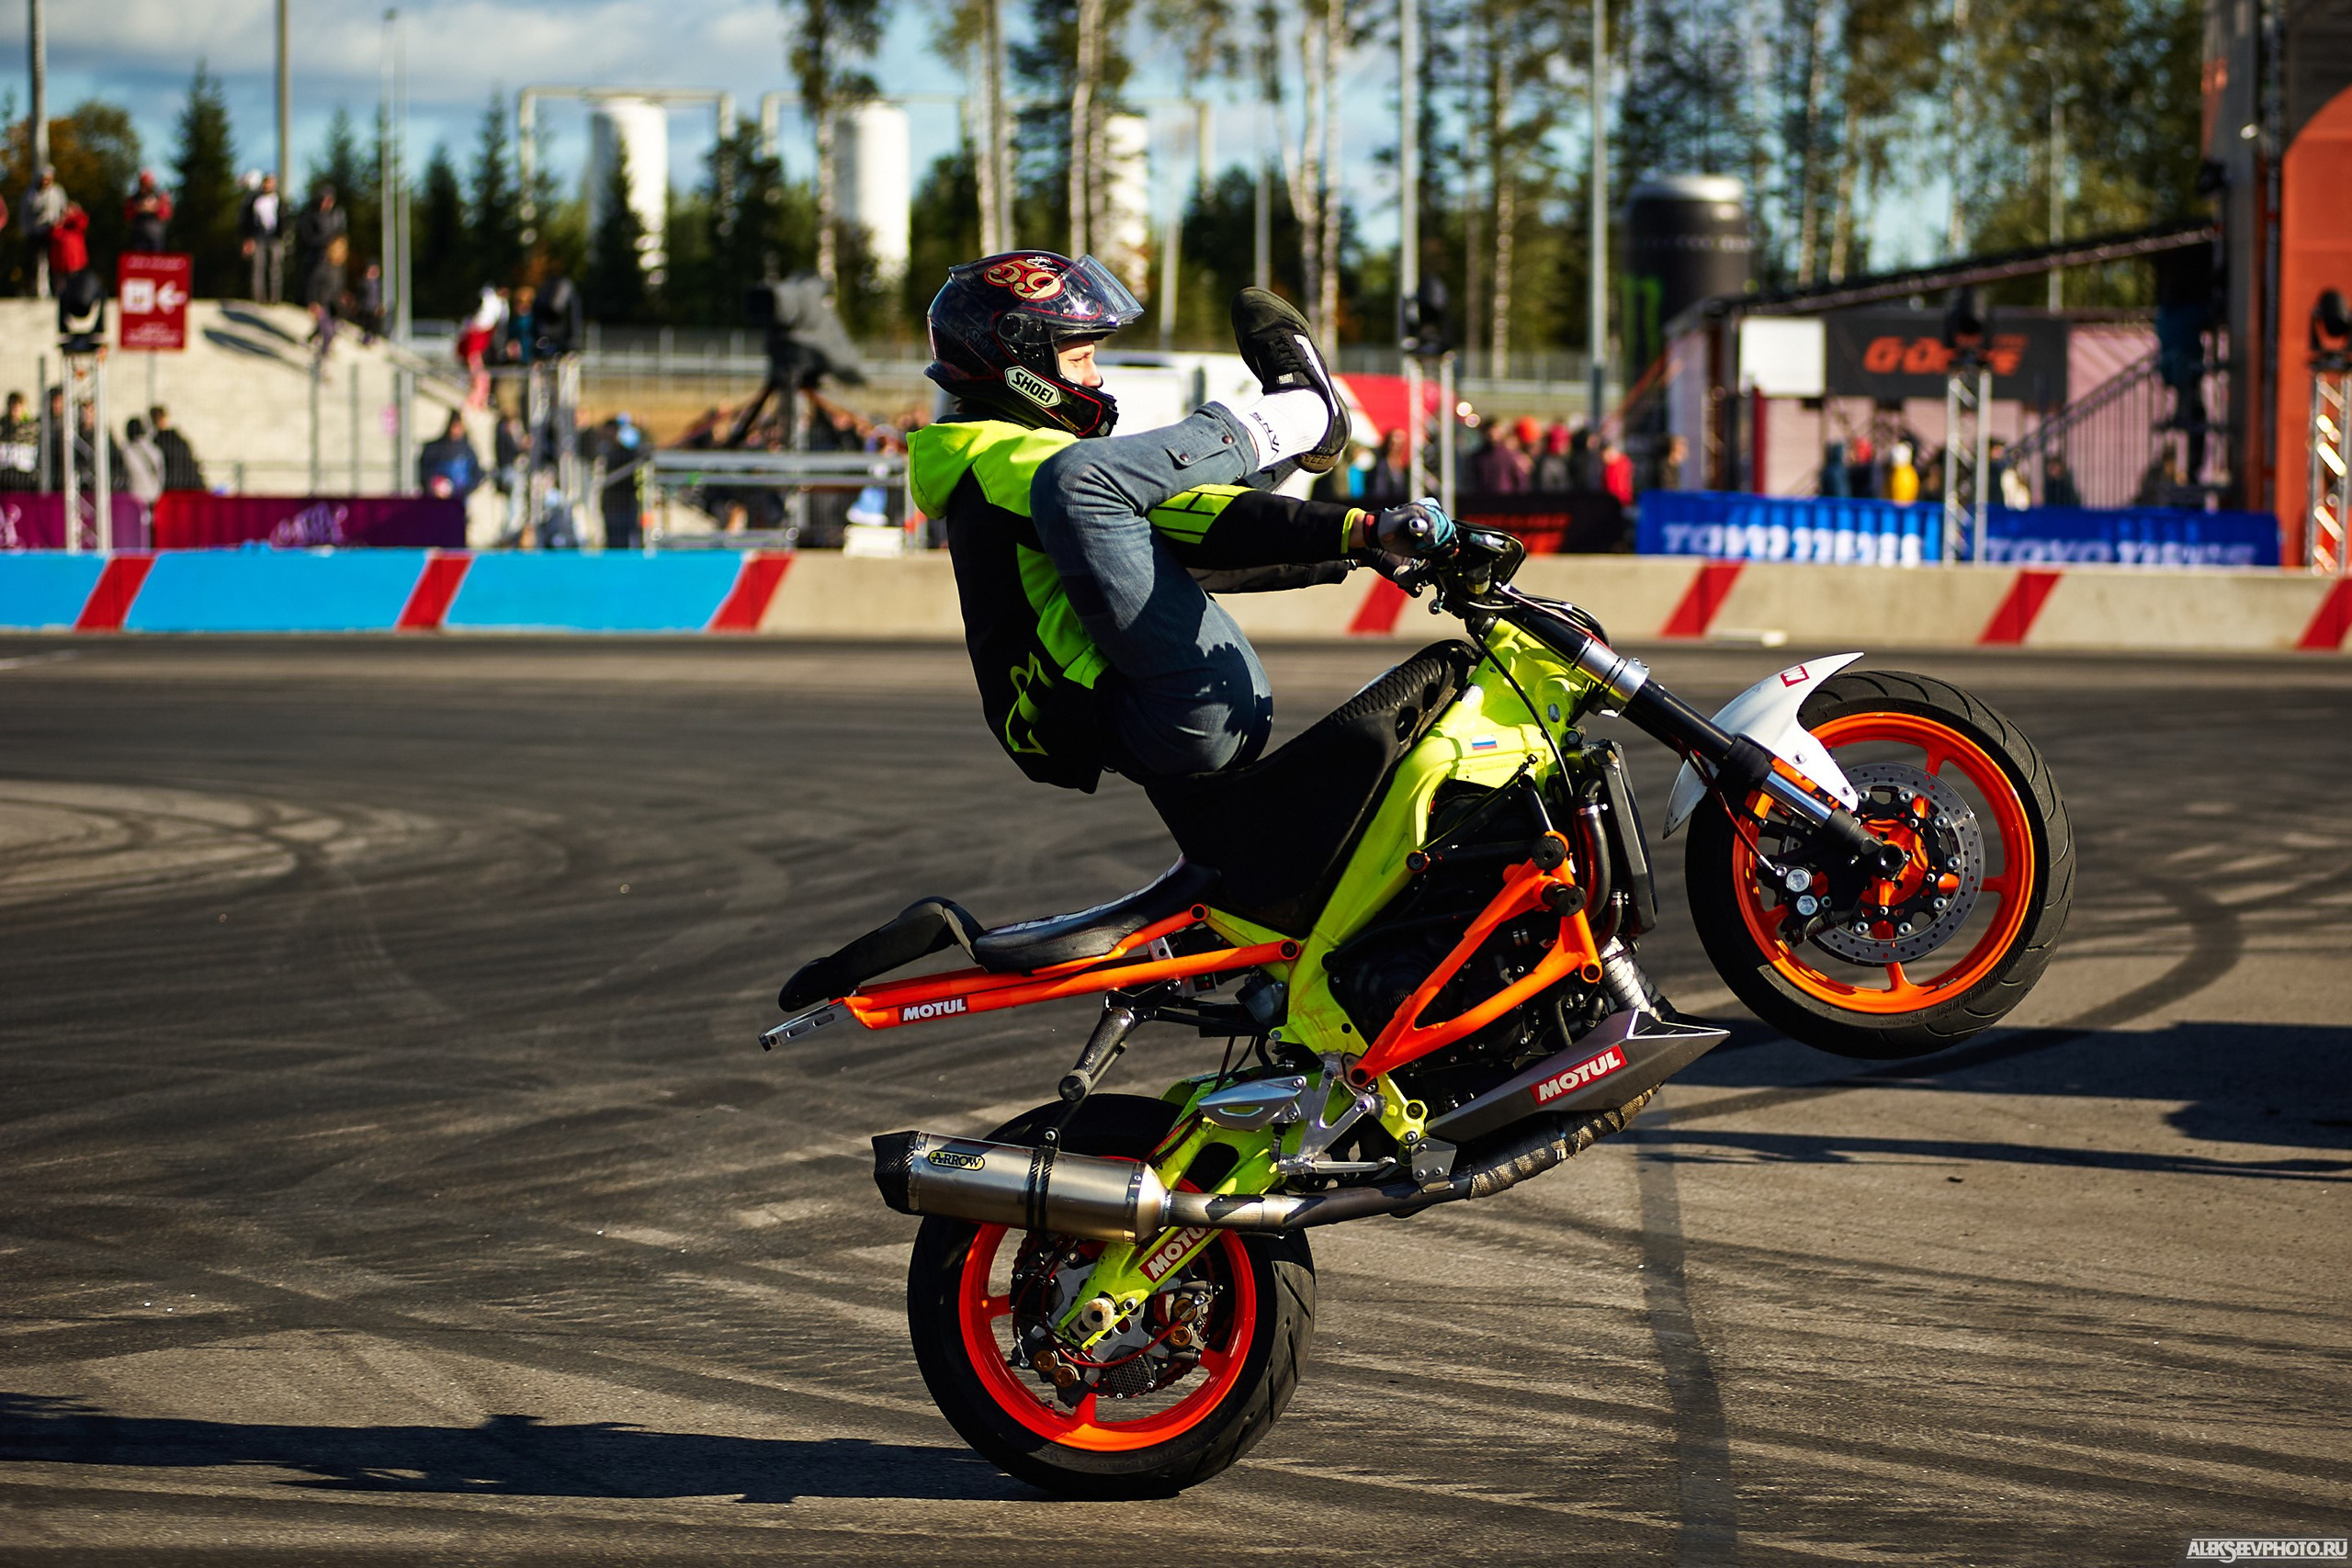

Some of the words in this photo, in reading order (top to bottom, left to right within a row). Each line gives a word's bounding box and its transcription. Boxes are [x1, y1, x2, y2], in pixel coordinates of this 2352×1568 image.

[1012, 371, 1054, 404] SHOEI
[903, 998, 966, 1021] MOTUL
[1538, 1051, 1621, 1101] MOTUL
[932, 1152, 981, 1168] ARROW
[1148, 1227, 1211, 1279] MOTU
